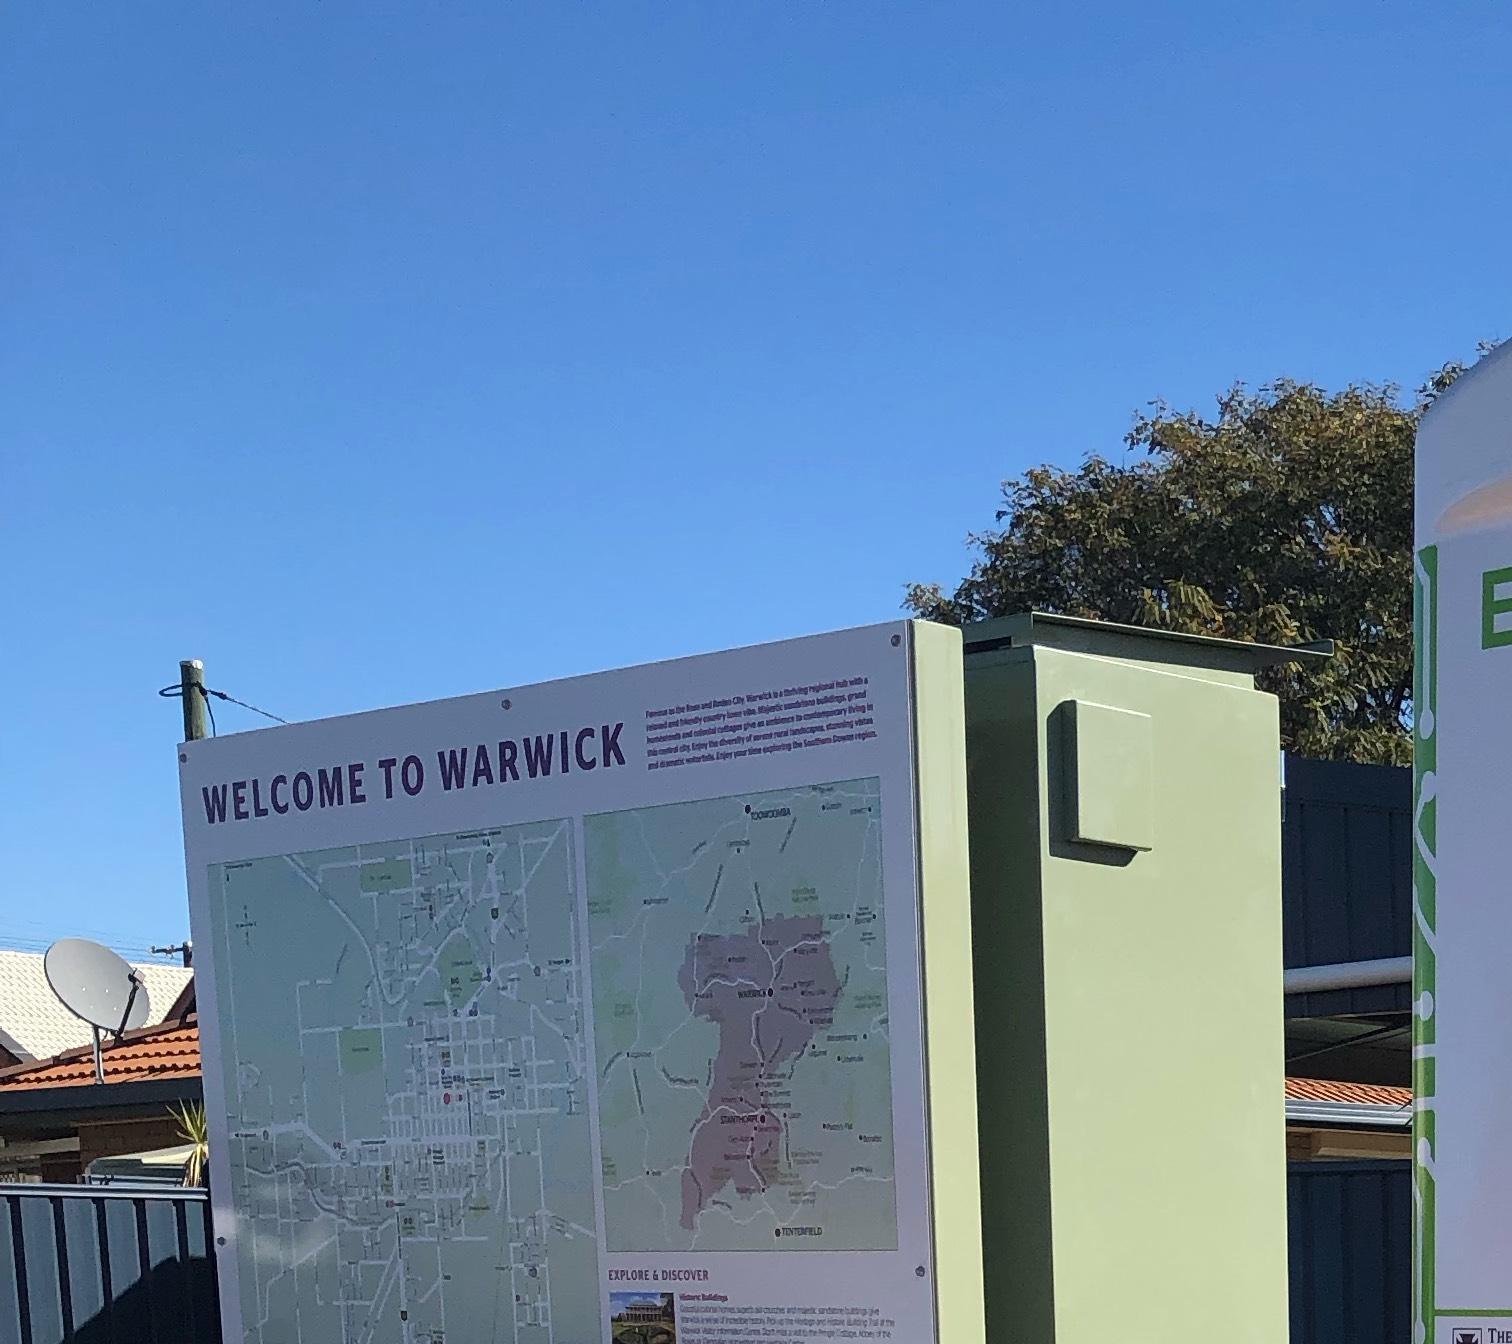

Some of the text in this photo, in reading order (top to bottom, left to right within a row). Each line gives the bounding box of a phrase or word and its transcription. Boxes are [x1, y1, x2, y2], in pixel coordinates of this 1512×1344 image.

[202, 722, 626, 824] WELCOME TO WARWICK
[608, 1269, 709, 1282] EXPLORE & DISCOVER
